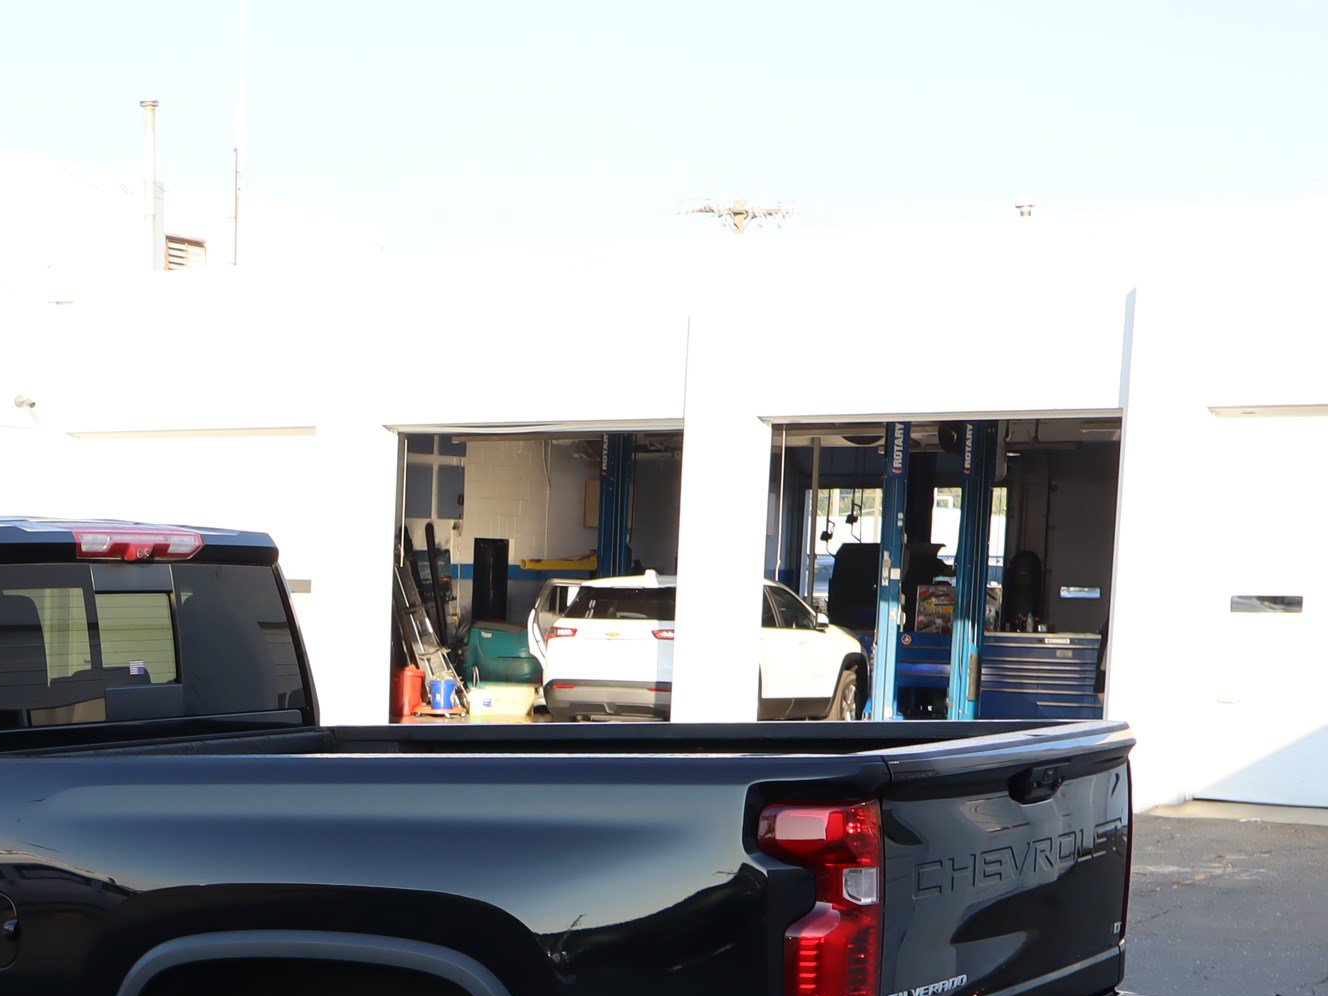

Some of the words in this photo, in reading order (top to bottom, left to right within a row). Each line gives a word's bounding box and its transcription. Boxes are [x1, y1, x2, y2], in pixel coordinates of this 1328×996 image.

[893, 423, 904, 468] ROTARY
[964, 424, 973, 468] ROTARY
[912, 816, 1128, 900] CHEVROLET
